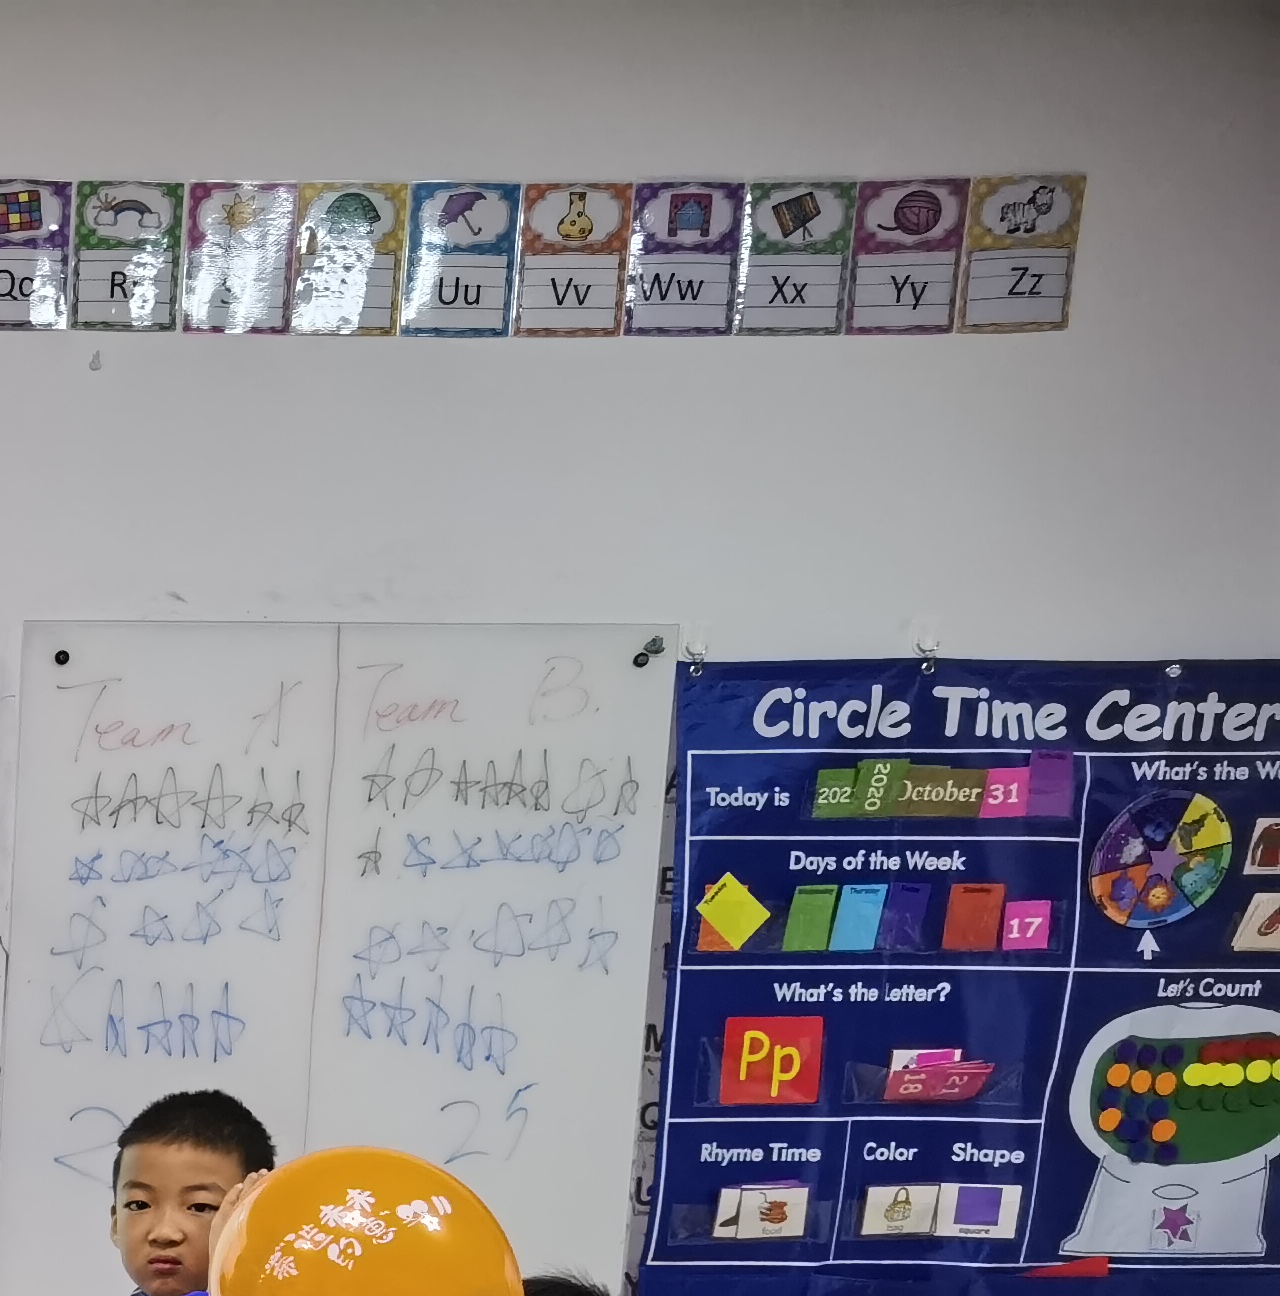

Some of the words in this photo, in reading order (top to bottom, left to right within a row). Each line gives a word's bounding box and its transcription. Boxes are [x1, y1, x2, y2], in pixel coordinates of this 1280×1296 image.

[438, 276, 482, 307] Uu
[550, 278, 593, 309] Vv
[643, 272, 704, 302] Ww
[769, 276, 808, 306] Xx
[890, 275, 930, 311] Yy
[1009, 267, 1044, 297] Zz
[357, 664, 466, 732] Team
[57, 676, 197, 761] Team
[752, 684, 912, 740] Circle
[931, 685, 1068, 742] Time
[1085, 689, 1280, 743] Center
[1131, 760, 1207, 781] What's
[1214, 760, 1249, 781] the
[706, 785, 767, 811] Today
[767, 786, 790, 807] is
[817, 785, 855, 804] 202
[864, 763, 891, 811] 2020
[989, 782, 1019, 805] 31
[789, 850, 836, 876] Days
[841, 849, 864, 871] of
[867, 850, 901, 871] the
[905, 850, 966, 871] Week
[1008, 918, 1042, 939] 17
[774, 982, 843, 1001] What's
[848, 983, 879, 1002] the
[1157, 979, 1194, 998] Let's
[1198, 978, 1262, 998] Count
[740, 1030, 801, 1098] Pp
[700, 1142, 763, 1166] Rhyme
[769, 1143, 821, 1162] Time
[863, 1142, 918, 1162] Color
[951, 1143, 1025, 1167] Shape
